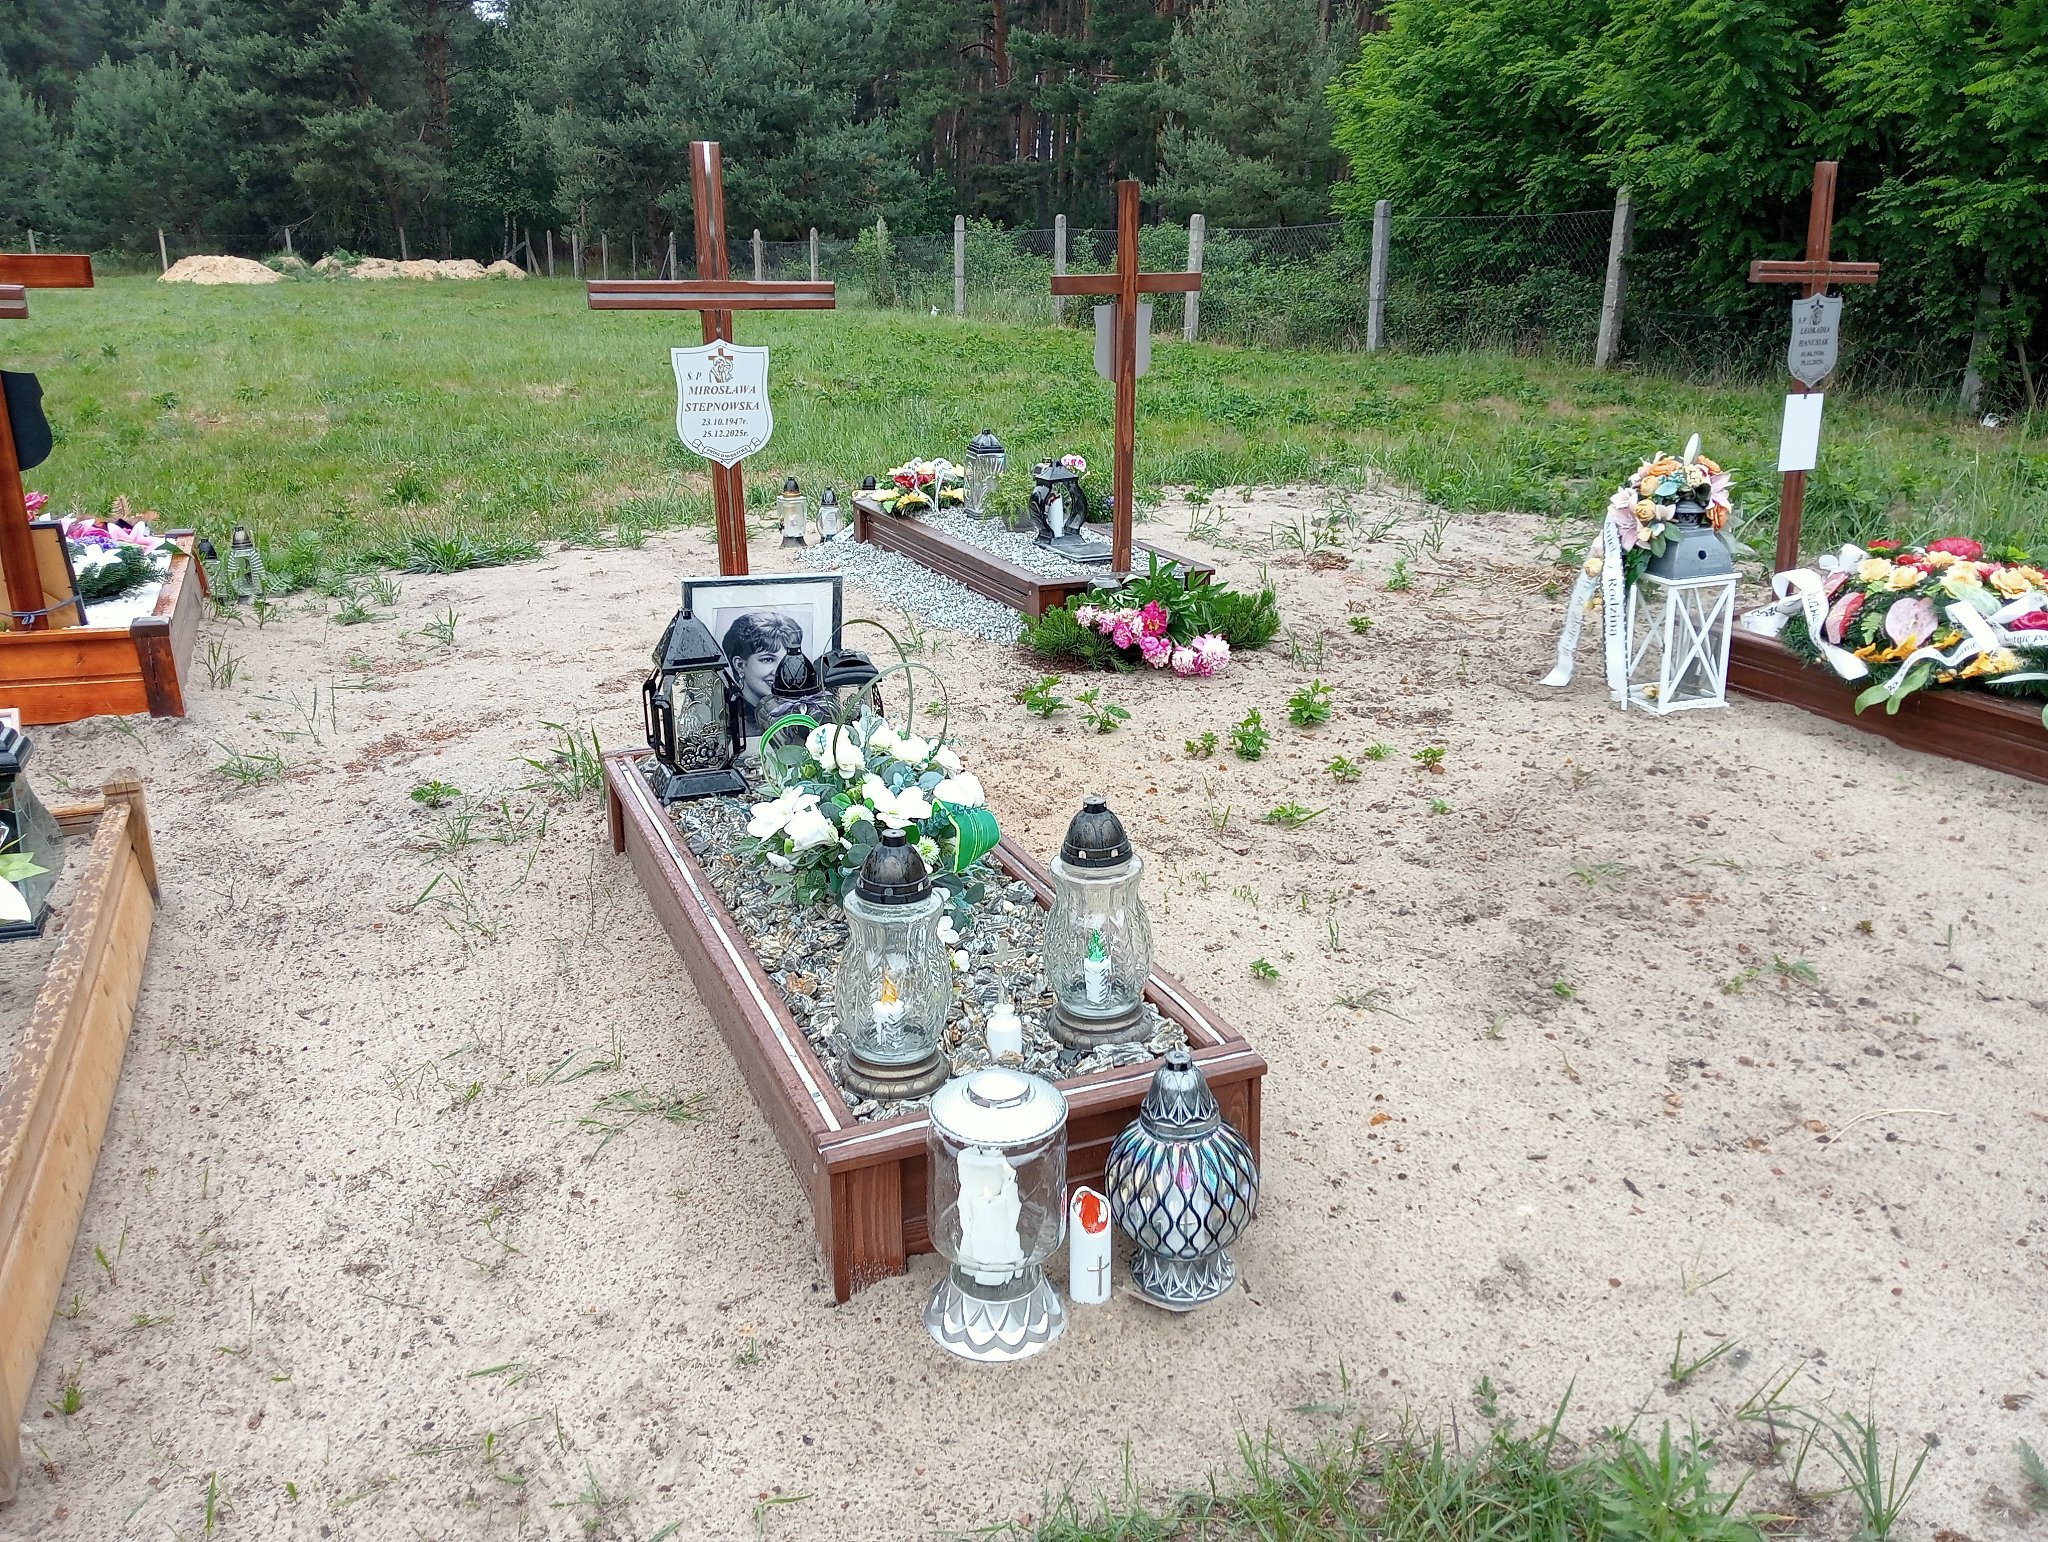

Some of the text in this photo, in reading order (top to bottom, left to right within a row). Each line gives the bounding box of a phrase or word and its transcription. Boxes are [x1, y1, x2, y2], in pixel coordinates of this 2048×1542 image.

[688, 385, 756, 396] MIROSŁAWA
[684, 401, 760, 412] STEPNOWSKA
[701, 417, 748, 426] 23.10.1947r.
[702, 429, 749, 438] 25.12.2025r.
